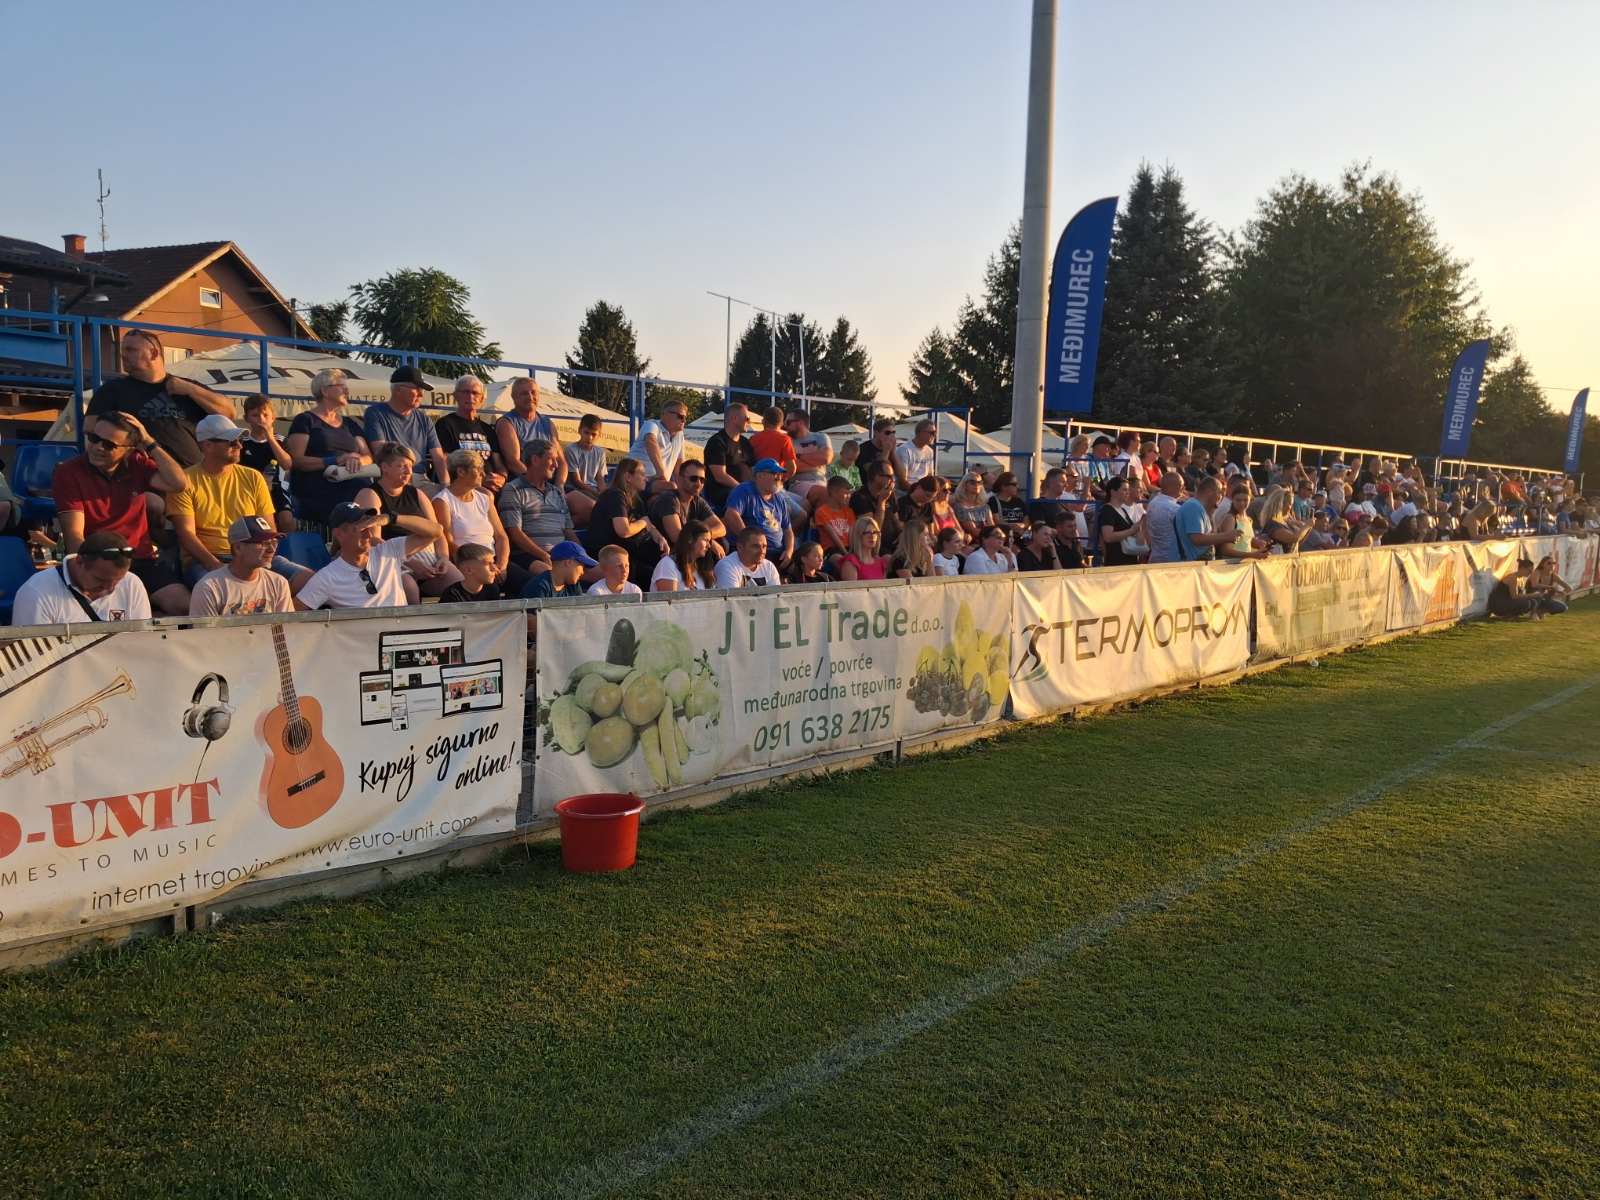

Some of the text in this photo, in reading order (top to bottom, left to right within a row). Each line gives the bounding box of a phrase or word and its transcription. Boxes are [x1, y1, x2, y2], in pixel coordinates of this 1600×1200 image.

[1059, 249, 1094, 384] MEĐIMUREC
[1447, 367, 1475, 441] MEĐIMUREC
[718, 598, 944, 655] J i EL Trade d.o.o.
[1051, 599, 1251, 665] TERMOPROM
[744, 676, 902, 714] međunarodna trgovina
[782, 662, 811, 682] voće
[829, 652, 873, 680] povrće
[754, 705, 891, 752] 091 638 2175
[358, 722, 499, 802] Kupuj sigurno
[455, 741, 516, 790] online!
[79, 854, 111, 872] TO
[133, 834, 217, 864] MUSIC
[92, 872, 186, 910] internet
[294, 815, 478, 859] ww.euro-unit.com
